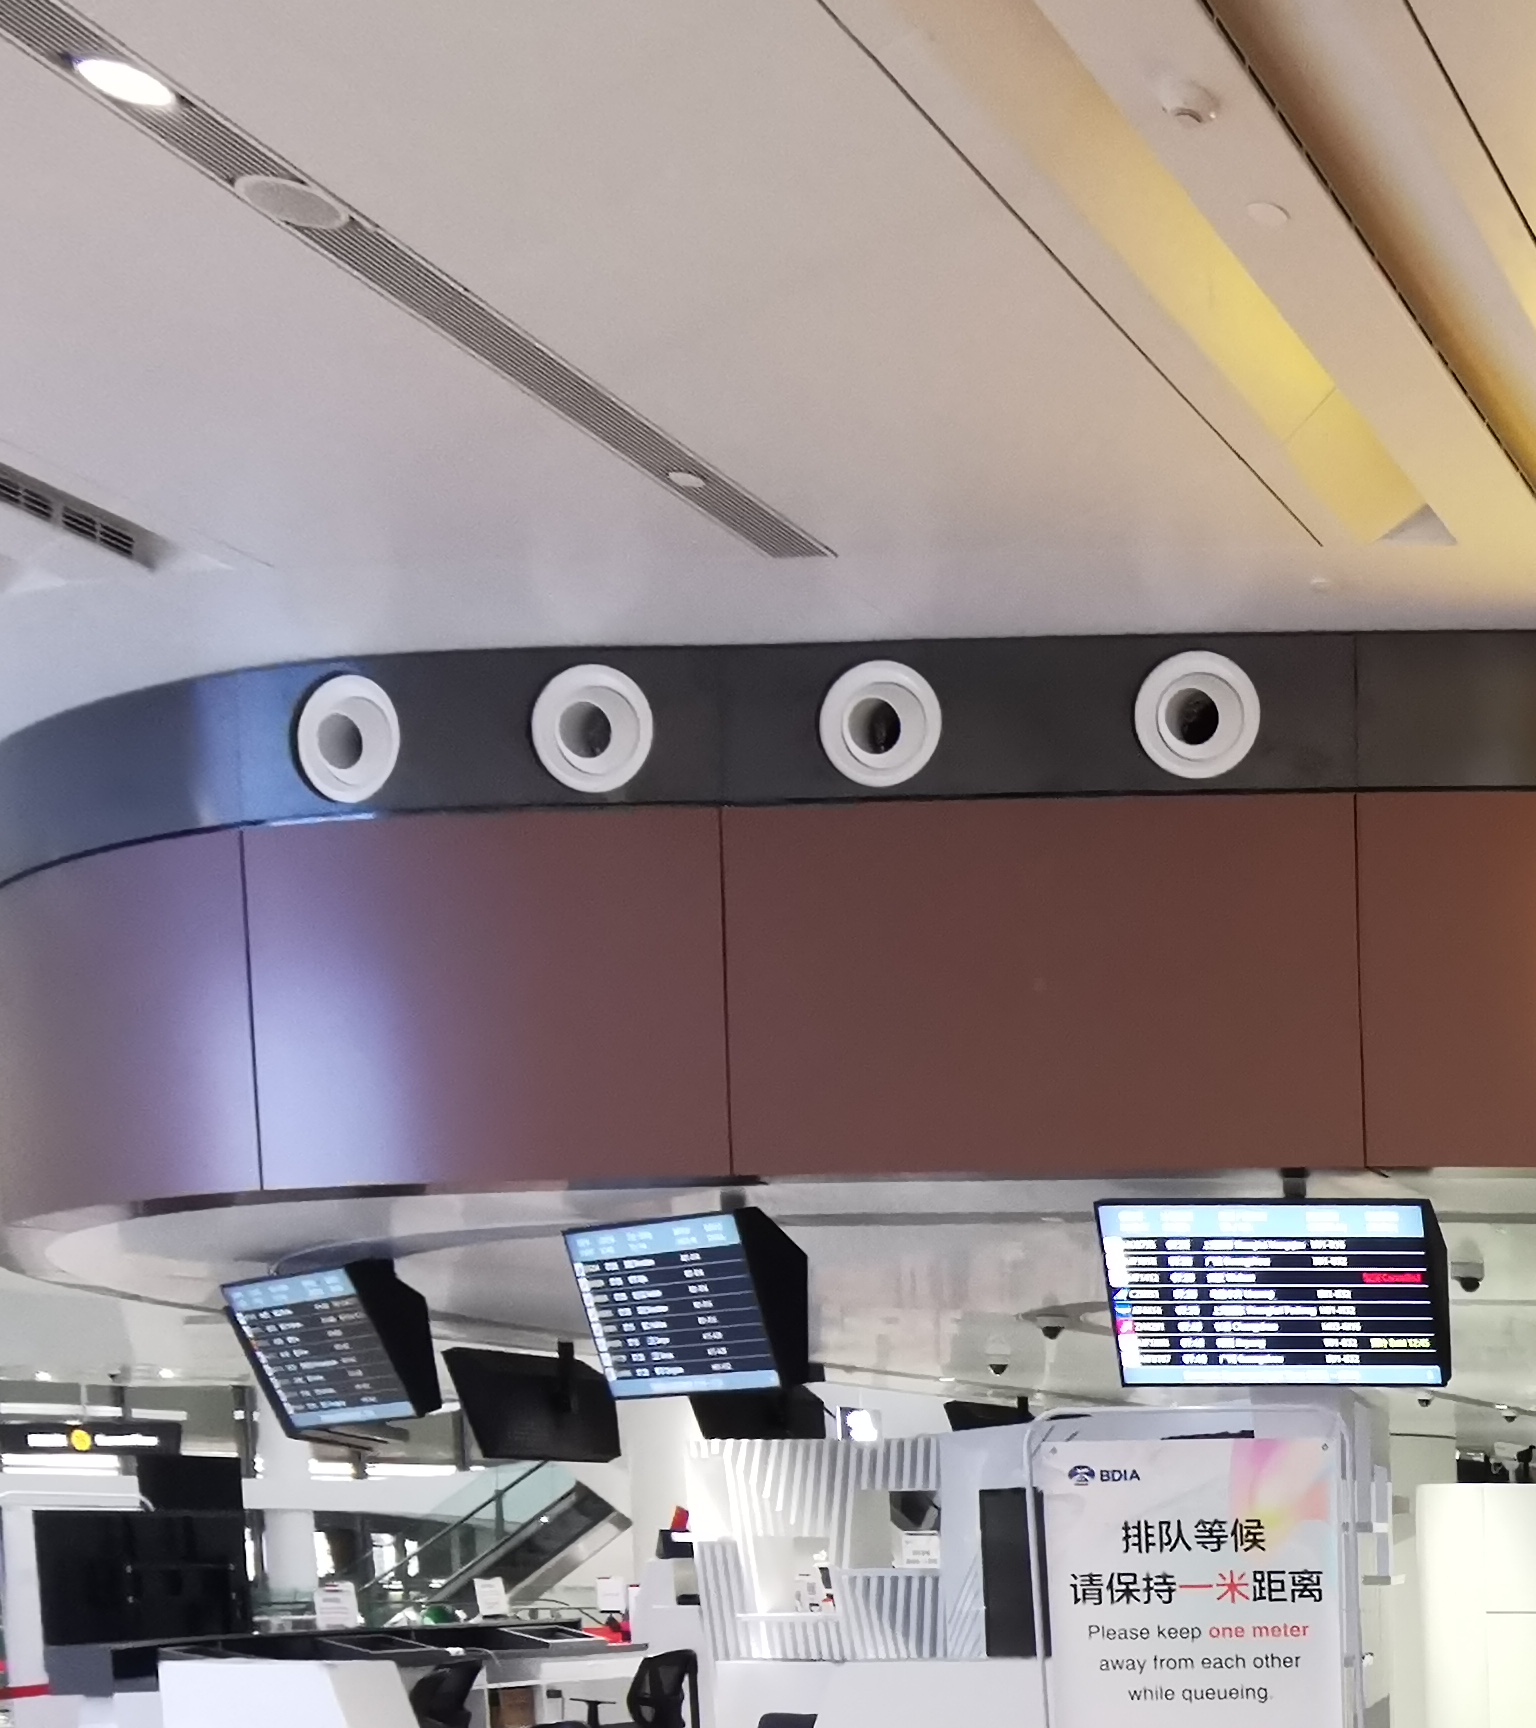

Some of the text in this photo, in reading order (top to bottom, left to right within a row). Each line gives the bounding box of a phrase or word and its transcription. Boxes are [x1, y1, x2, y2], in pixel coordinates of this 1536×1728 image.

[1100, 1469, 1141, 1482] BDIA
[1121, 1518, 1267, 1554] 排队等候
[1070, 1569, 1323, 1606] 请保持一米距离
[1088, 1623, 1310, 1643] Please keep one meter
[1099, 1653, 1301, 1675] away from each other
[1128, 1686, 1175, 1701] while
